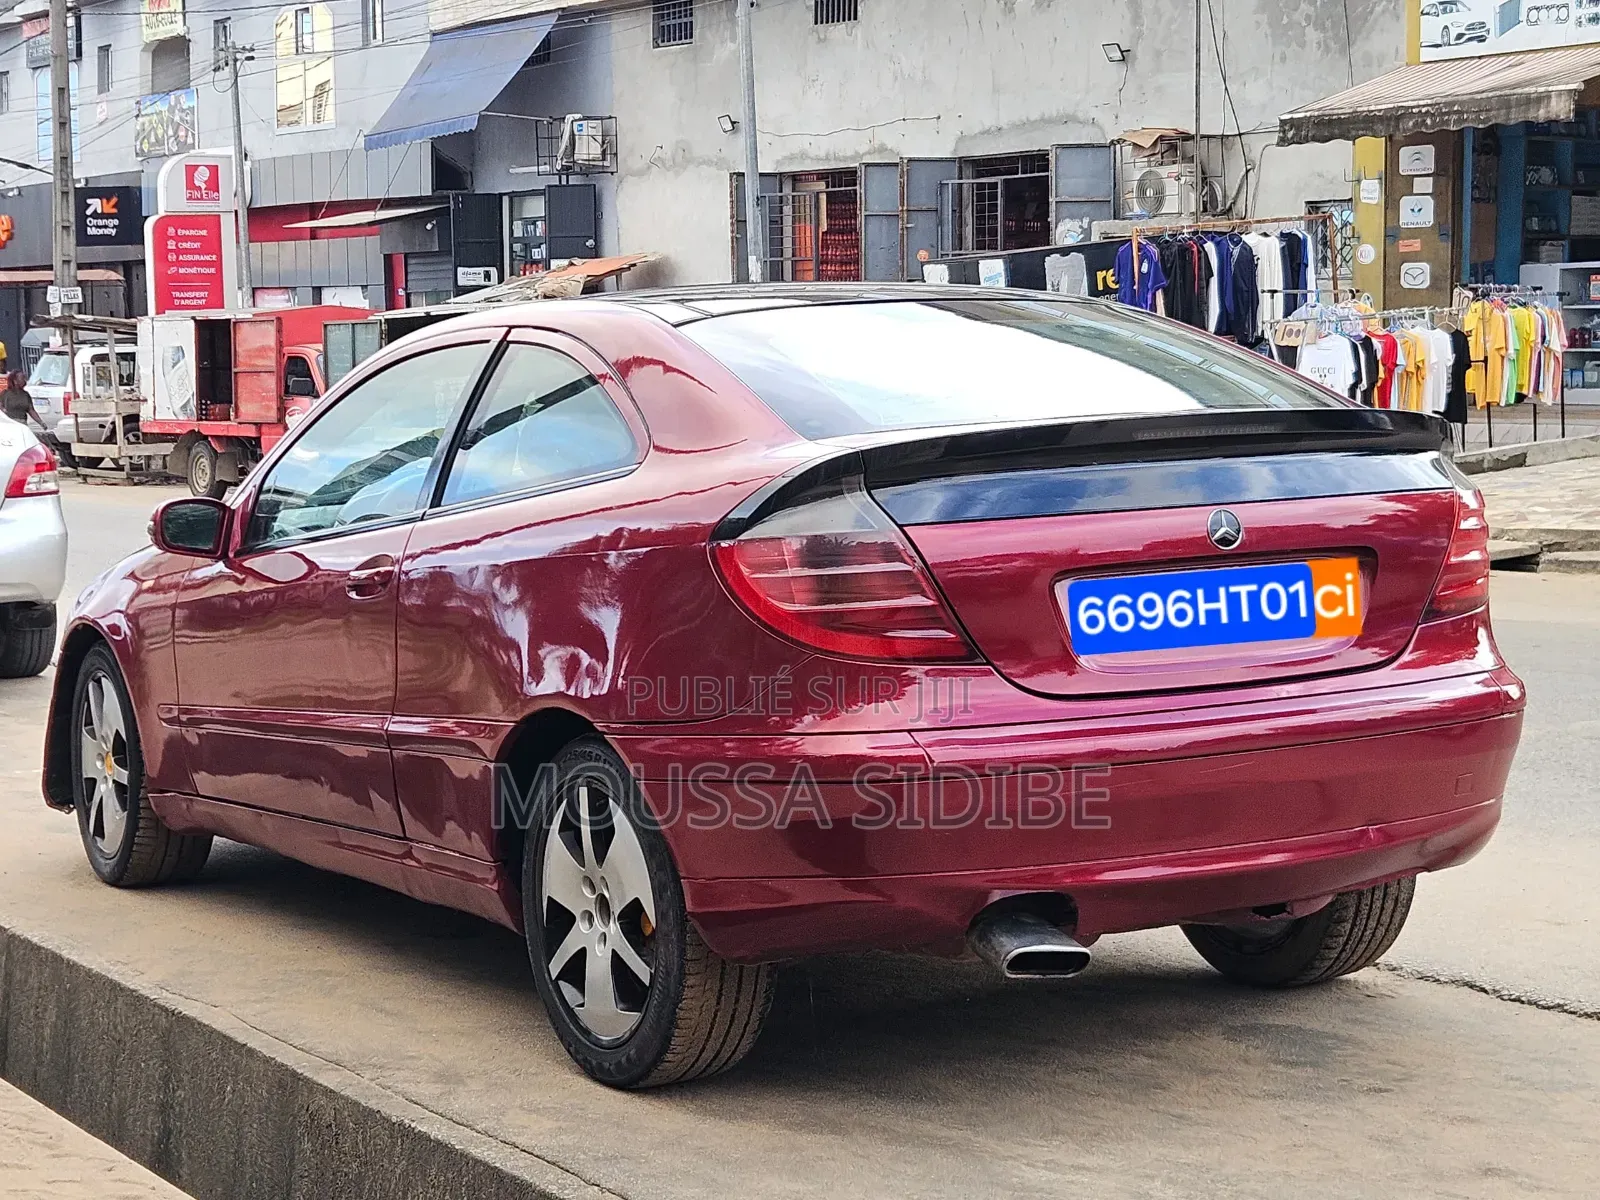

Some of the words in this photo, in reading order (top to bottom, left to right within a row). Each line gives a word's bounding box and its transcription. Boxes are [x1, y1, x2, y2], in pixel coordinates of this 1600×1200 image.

[86, 217, 119, 227] Orange
[87, 226, 117, 236] Money
[177, 241, 201, 249] CRÉDIT
[1359, 249, 1371, 259] KIA
[178, 266, 217, 274] MONÉTIQUE
[174, 298, 207, 306] D'ARGENT
[1310, 366, 1336, 375] GUCCI
